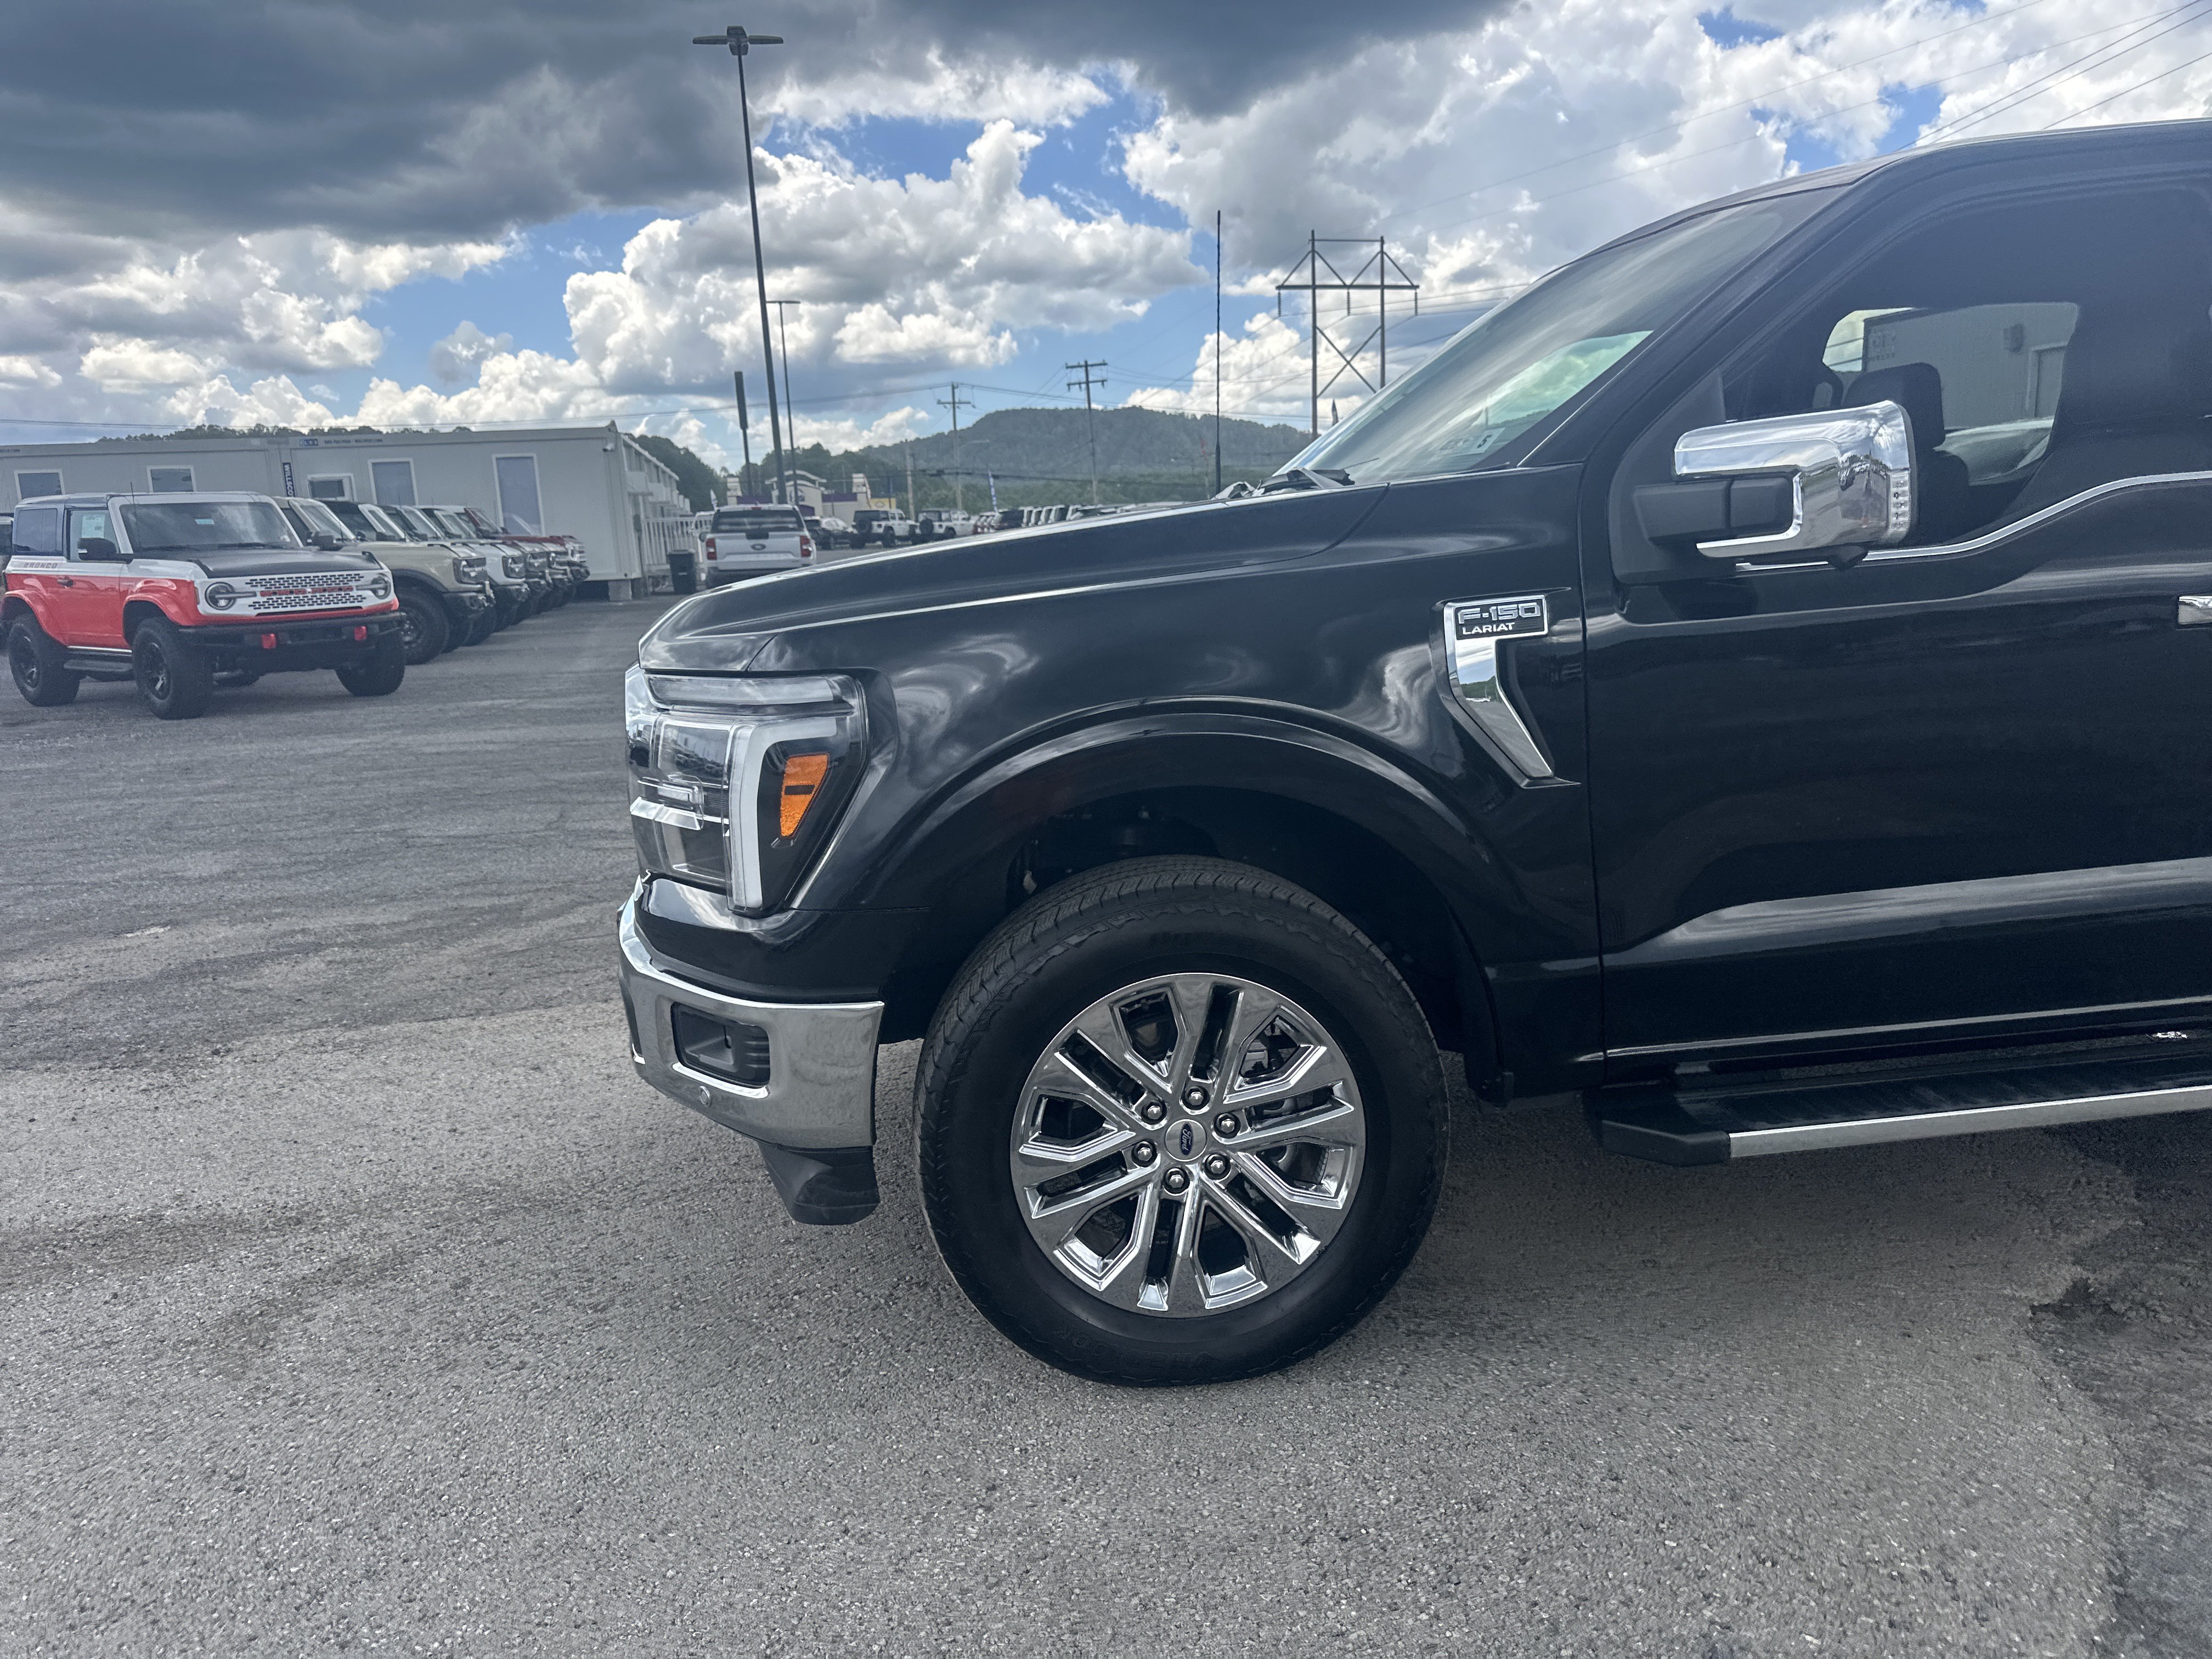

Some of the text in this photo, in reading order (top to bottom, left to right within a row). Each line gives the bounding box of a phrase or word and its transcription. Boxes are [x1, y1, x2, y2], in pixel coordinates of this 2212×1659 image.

[284, 464, 294, 497] WILLSCO
[1458, 602, 1541, 624] F-150
[1462, 622, 1515, 635] LARIAT
[1181, 1128, 1192, 1151] Ford
